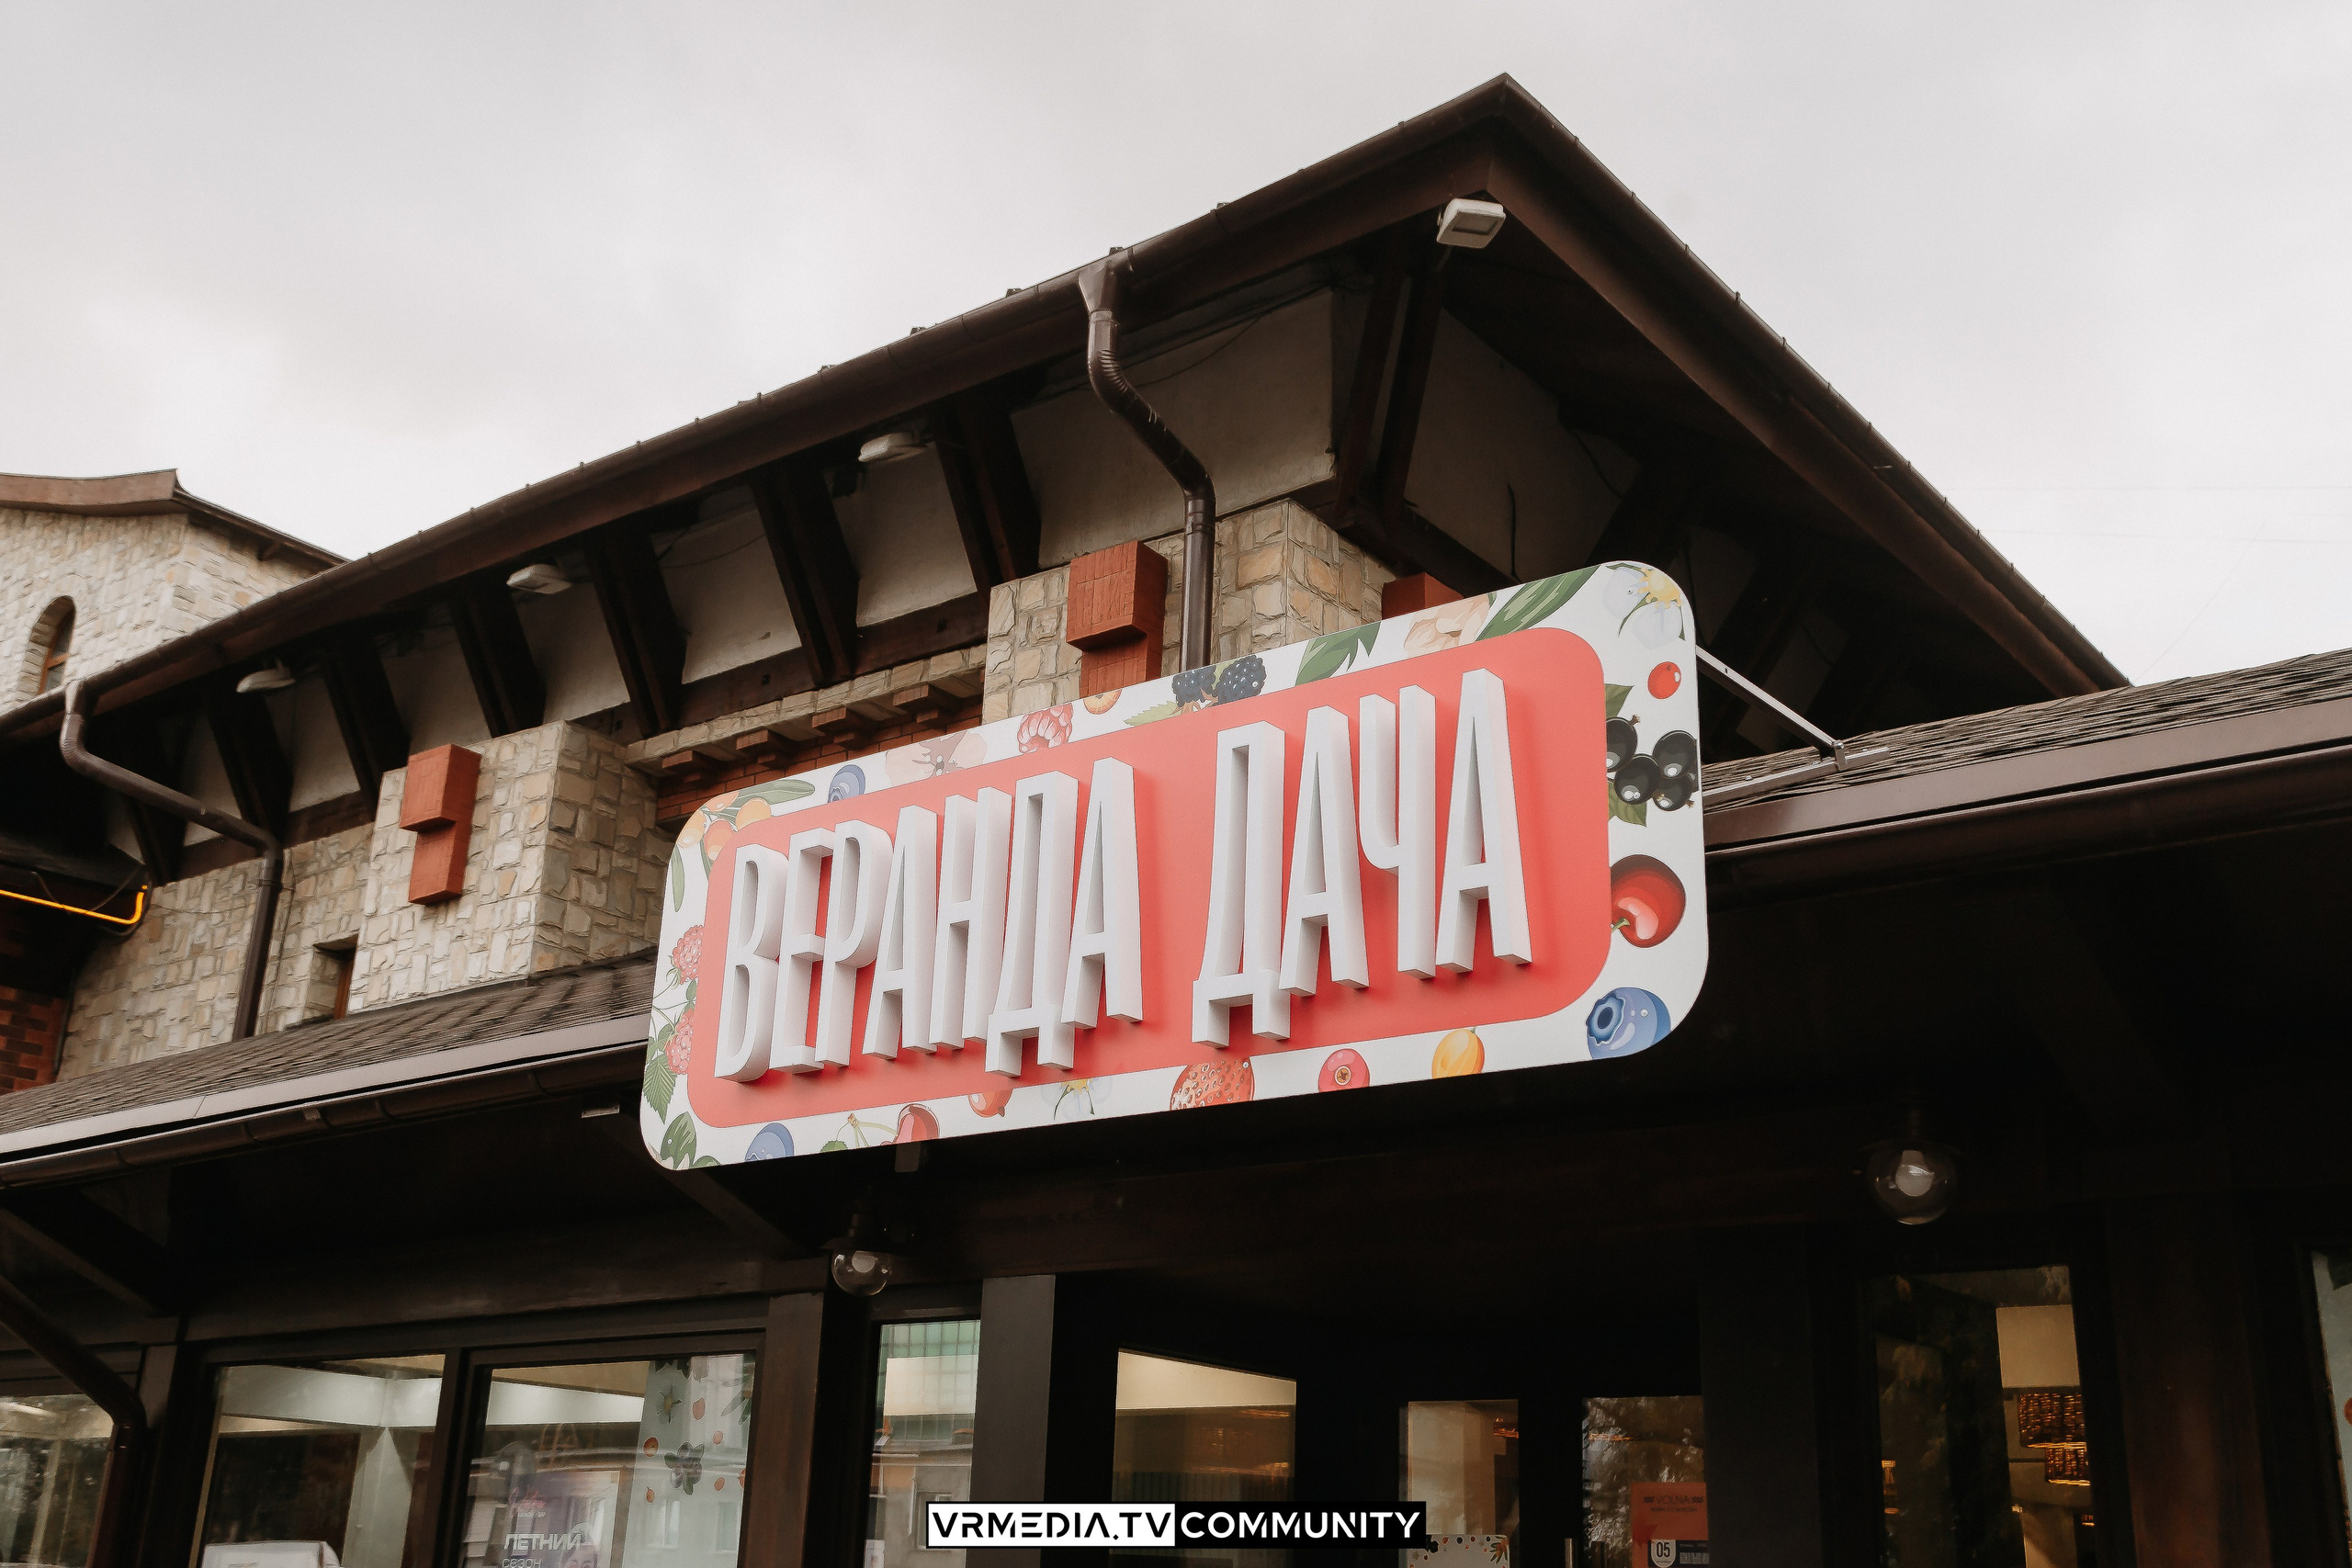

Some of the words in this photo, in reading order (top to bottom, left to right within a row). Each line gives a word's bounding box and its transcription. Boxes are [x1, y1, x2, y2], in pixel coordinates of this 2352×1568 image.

[714, 757, 1143, 1082] ВЕРАНДА
[1192, 668, 1532, 1047] ДАЧА
[1657, 1541, 1670, 1558] 05
